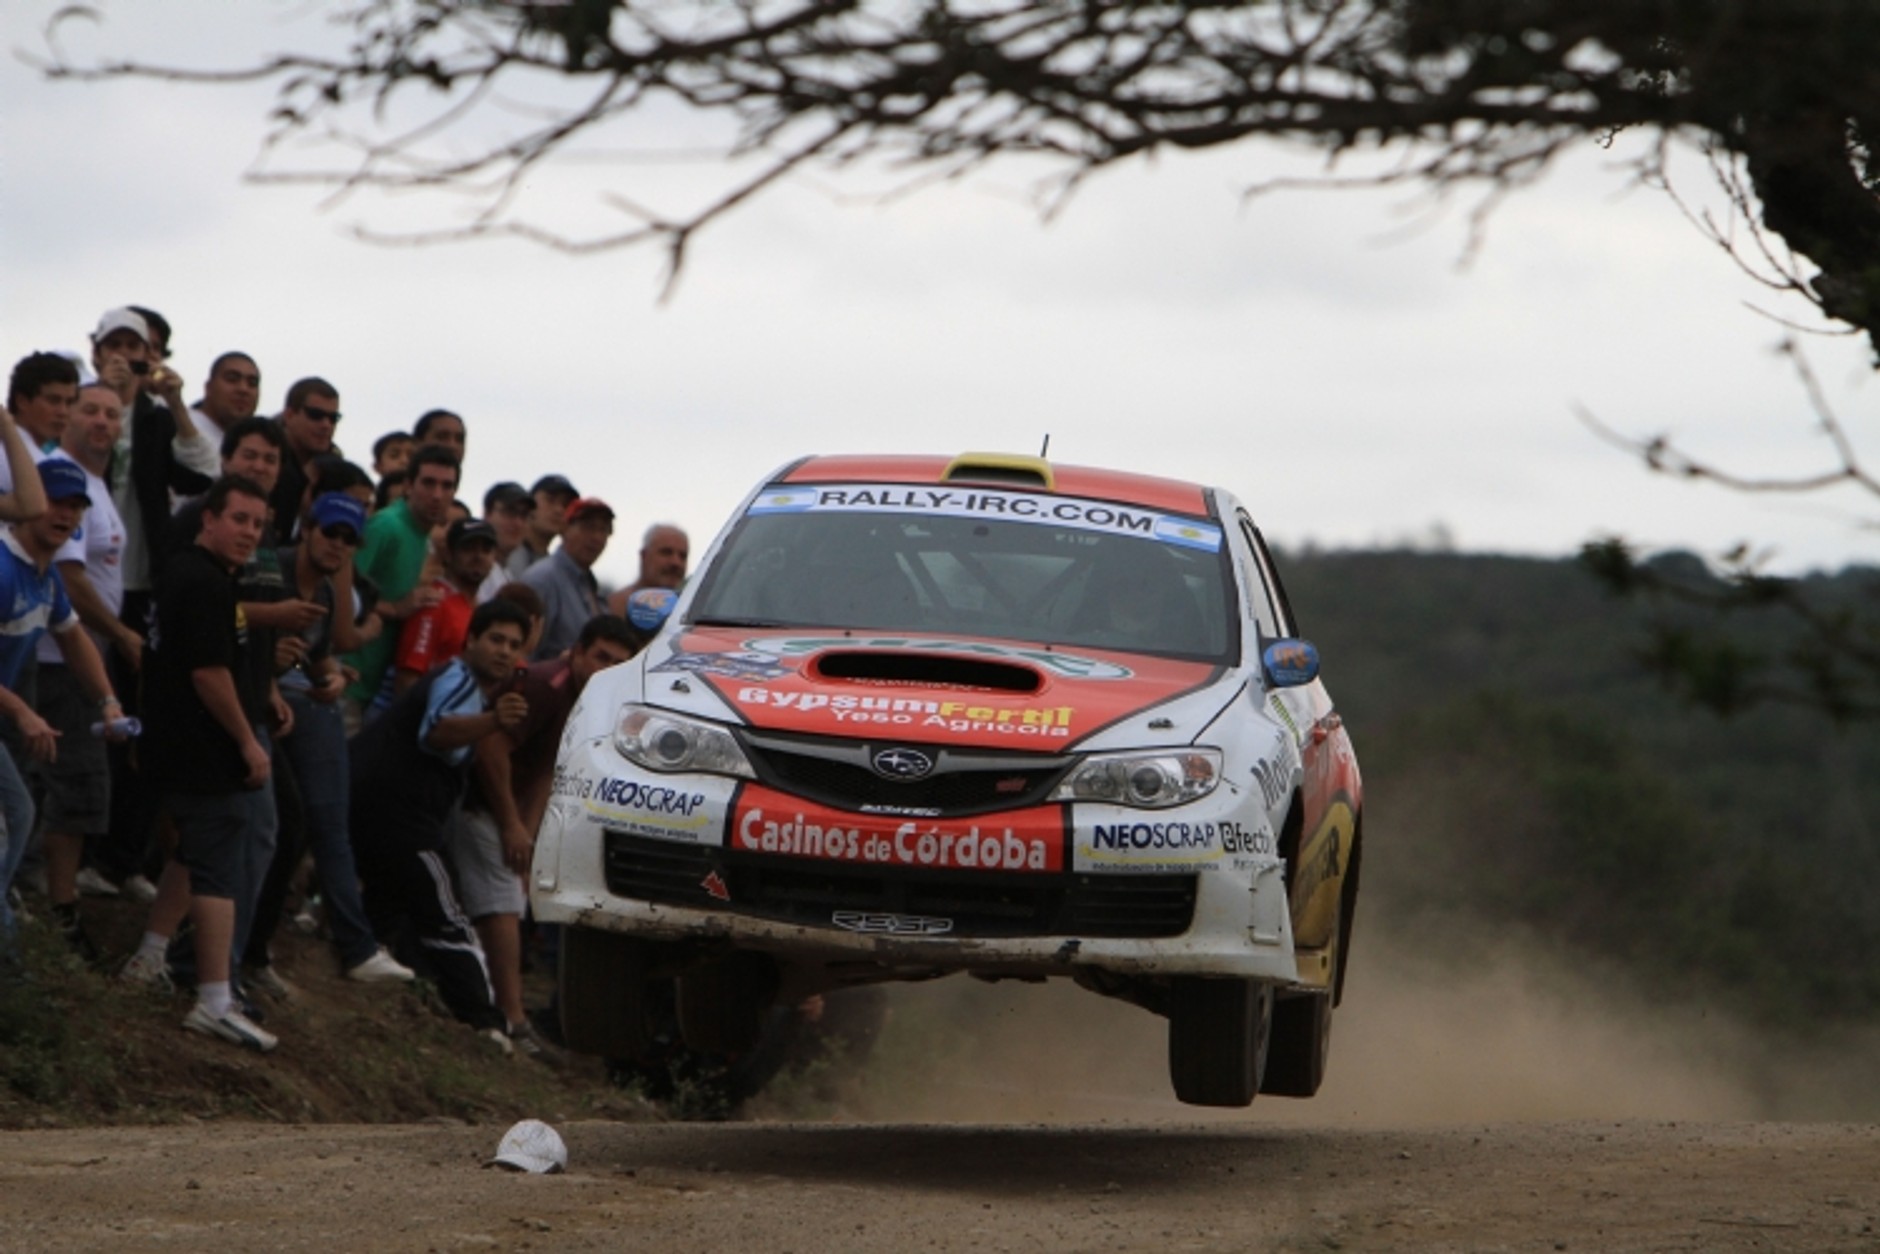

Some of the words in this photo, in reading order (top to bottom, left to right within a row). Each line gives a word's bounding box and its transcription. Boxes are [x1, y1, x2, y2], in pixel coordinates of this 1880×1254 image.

[819, 490, 1152, 531] RALLY-IRC.COM
[831, 707, 911, 724] Yeso
[594, 777, 705, 816] NEOSCRAP
[739, 808, 859, 859] Casinos
[863, 833, 891, 861] de
[895, 822, 1047, 870] Córdoba
[1093, 822, 1215, 849] NEOSCRAP
